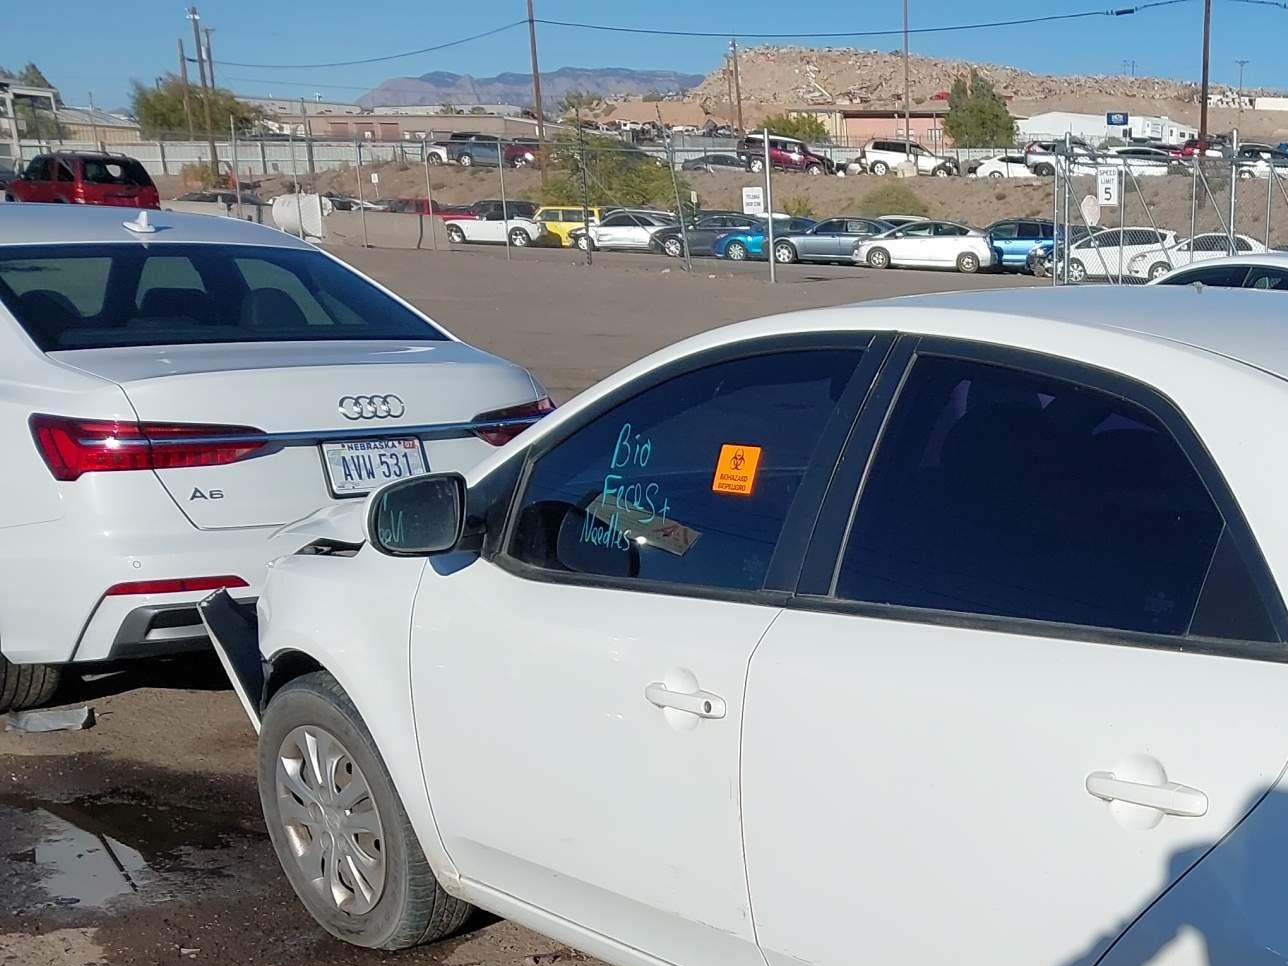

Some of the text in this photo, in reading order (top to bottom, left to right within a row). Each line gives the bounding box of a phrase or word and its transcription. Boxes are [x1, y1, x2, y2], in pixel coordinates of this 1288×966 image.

[1104, 187, 1112, 201] 5
[346, 441, 398, 452] NEBRASKA
[610, 423, 651, 469] Bio
[341, 452, 413, 481] AVW 531
[190, 487, 225, 501] A6
[579, 508, 633, 551] Needles
